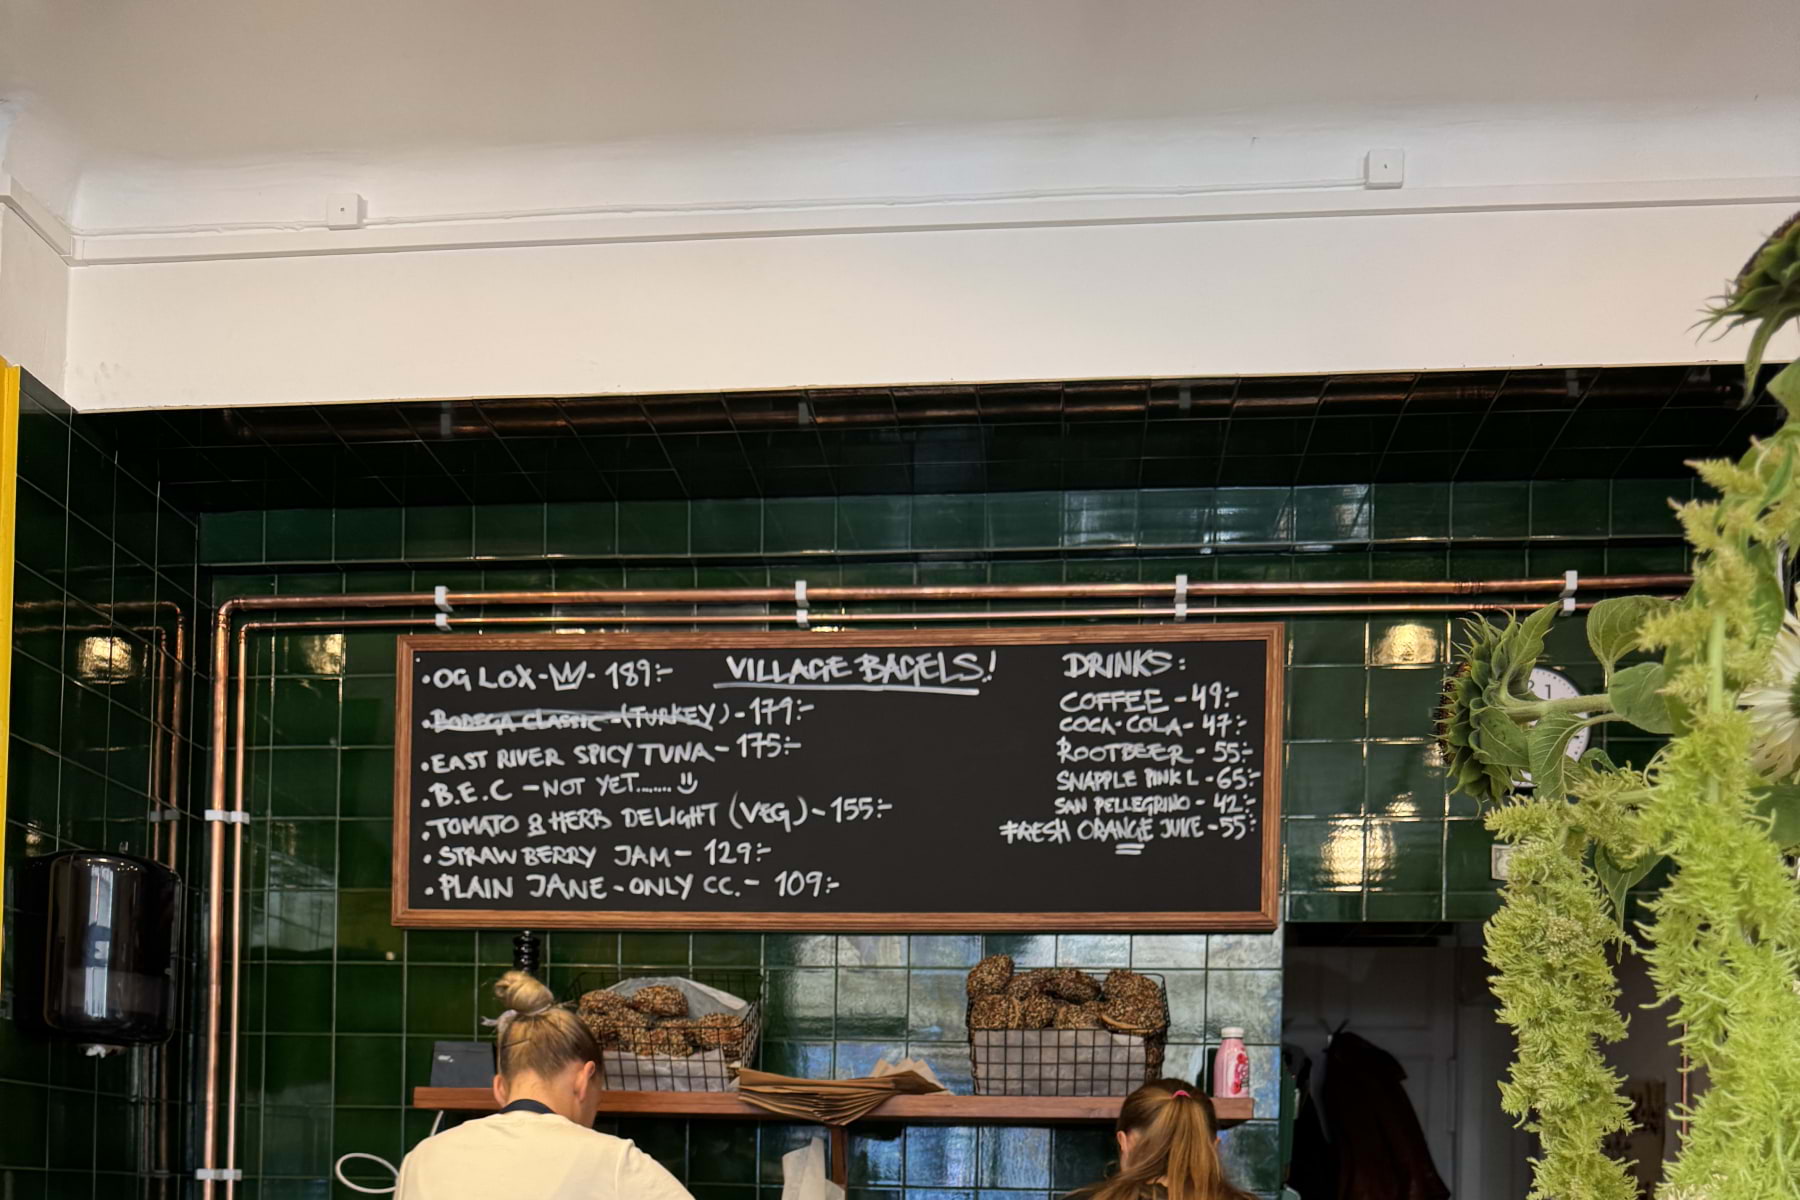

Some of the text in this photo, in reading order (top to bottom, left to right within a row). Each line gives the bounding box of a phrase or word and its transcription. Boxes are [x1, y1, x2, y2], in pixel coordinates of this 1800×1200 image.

[433, 668, 472, 691] OG
[726, 649, 996, 687] VILLAGE BAGELS!
[1059, 689, 1169, 714] COFFEE
[430, 751, 488, 774] EAST
[497, 747, 565, 769] RIVER
[573, 743, 633, 769] SPICY
[1057, 736, 1194, 766] ROOTBEER
[1056, 769, 1137, 792] SNAPPLE
[1144, 769, 1182, 788] PINK
[1186, 769, 1199, 786] L
[425, 814, 520, 839] TOMATO
[527, 813, 547, 837] &
[548, 807, 612, 834] HERB
[621, 802, 719, 829] DELIGHT
[729, 791, 808, 833] (VEG)
[1054, 797, 1087, 816] SAN
[1094, 794, 1190, 817] PELLEGRINO
[999, 817, 1071, 844] FRESH
[1077, 816, 1154, 842] ORANGE
[614, 845, 672, 868] JAM
[439, 873, 513, 901] PLAIN
[526, 873, 607, 900] JANE
[629, 873, 694, 900] ONLY
